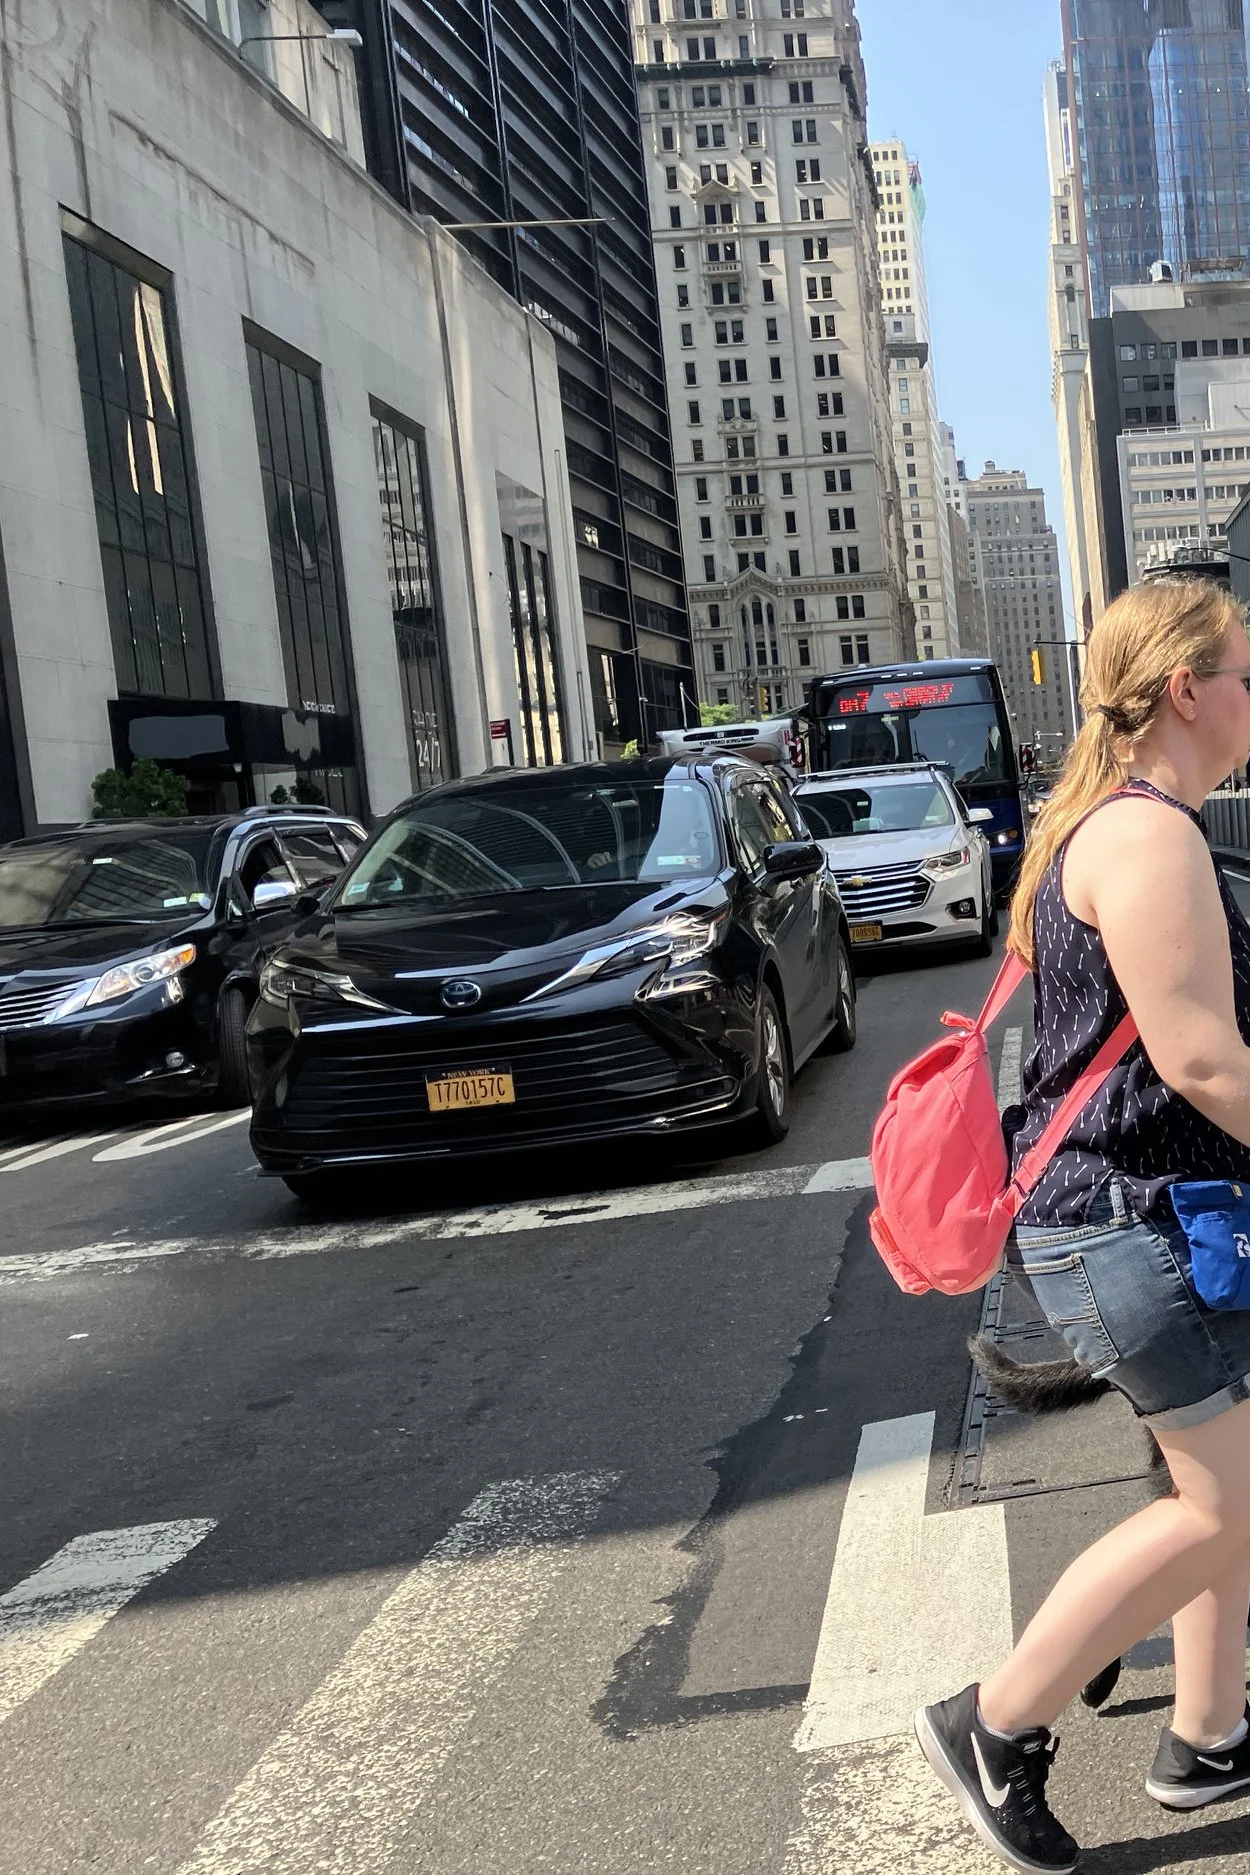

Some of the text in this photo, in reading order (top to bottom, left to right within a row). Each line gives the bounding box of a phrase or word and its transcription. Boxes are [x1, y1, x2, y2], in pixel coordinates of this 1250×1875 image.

[416, 737, 441, 772] 24/7
[447, 1067, 490, 1079] NEW YORK
[435, 1077, 505, 1102] T770157C
